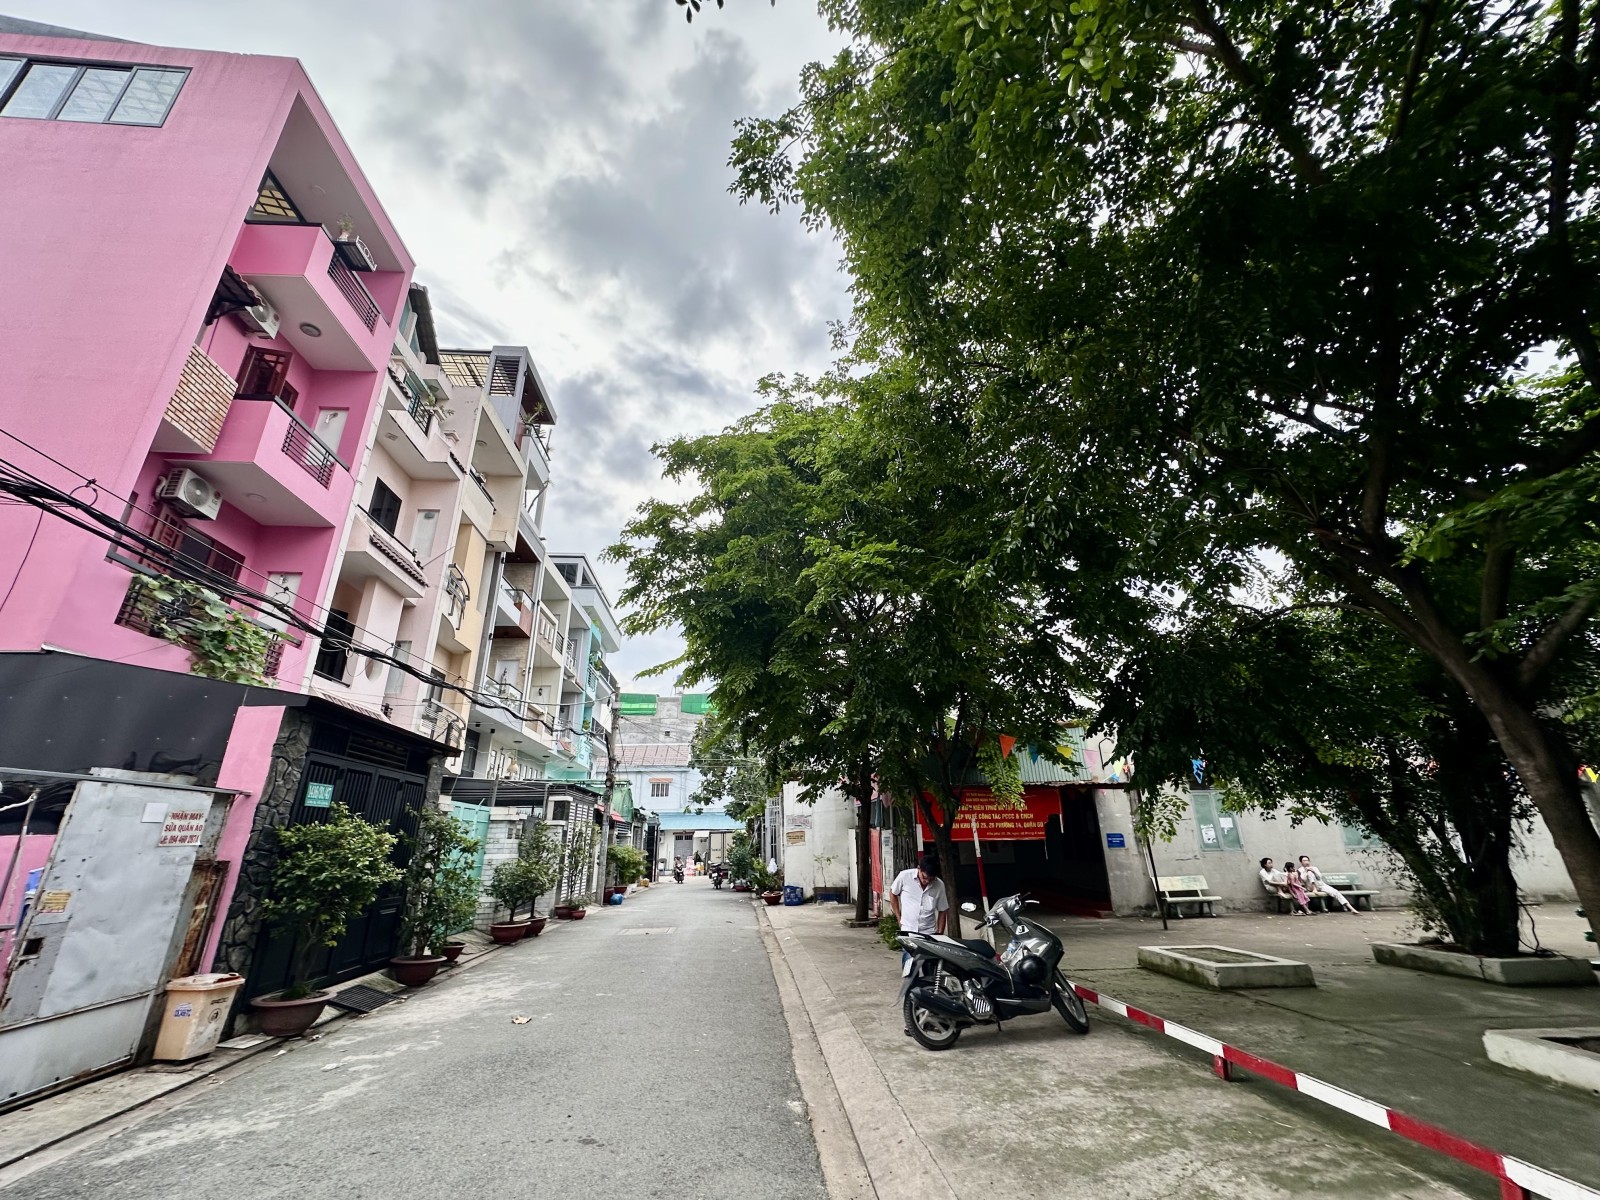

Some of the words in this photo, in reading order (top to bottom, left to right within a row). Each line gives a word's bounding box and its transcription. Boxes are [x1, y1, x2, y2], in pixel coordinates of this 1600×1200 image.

[978, 812, 992, 820] CÔNG
[992, 812, 1002, 820] TÁC
[995, 821, 1015, 829] PHƯỜNG
[1023, 821, 1037, 830] QUẬN
